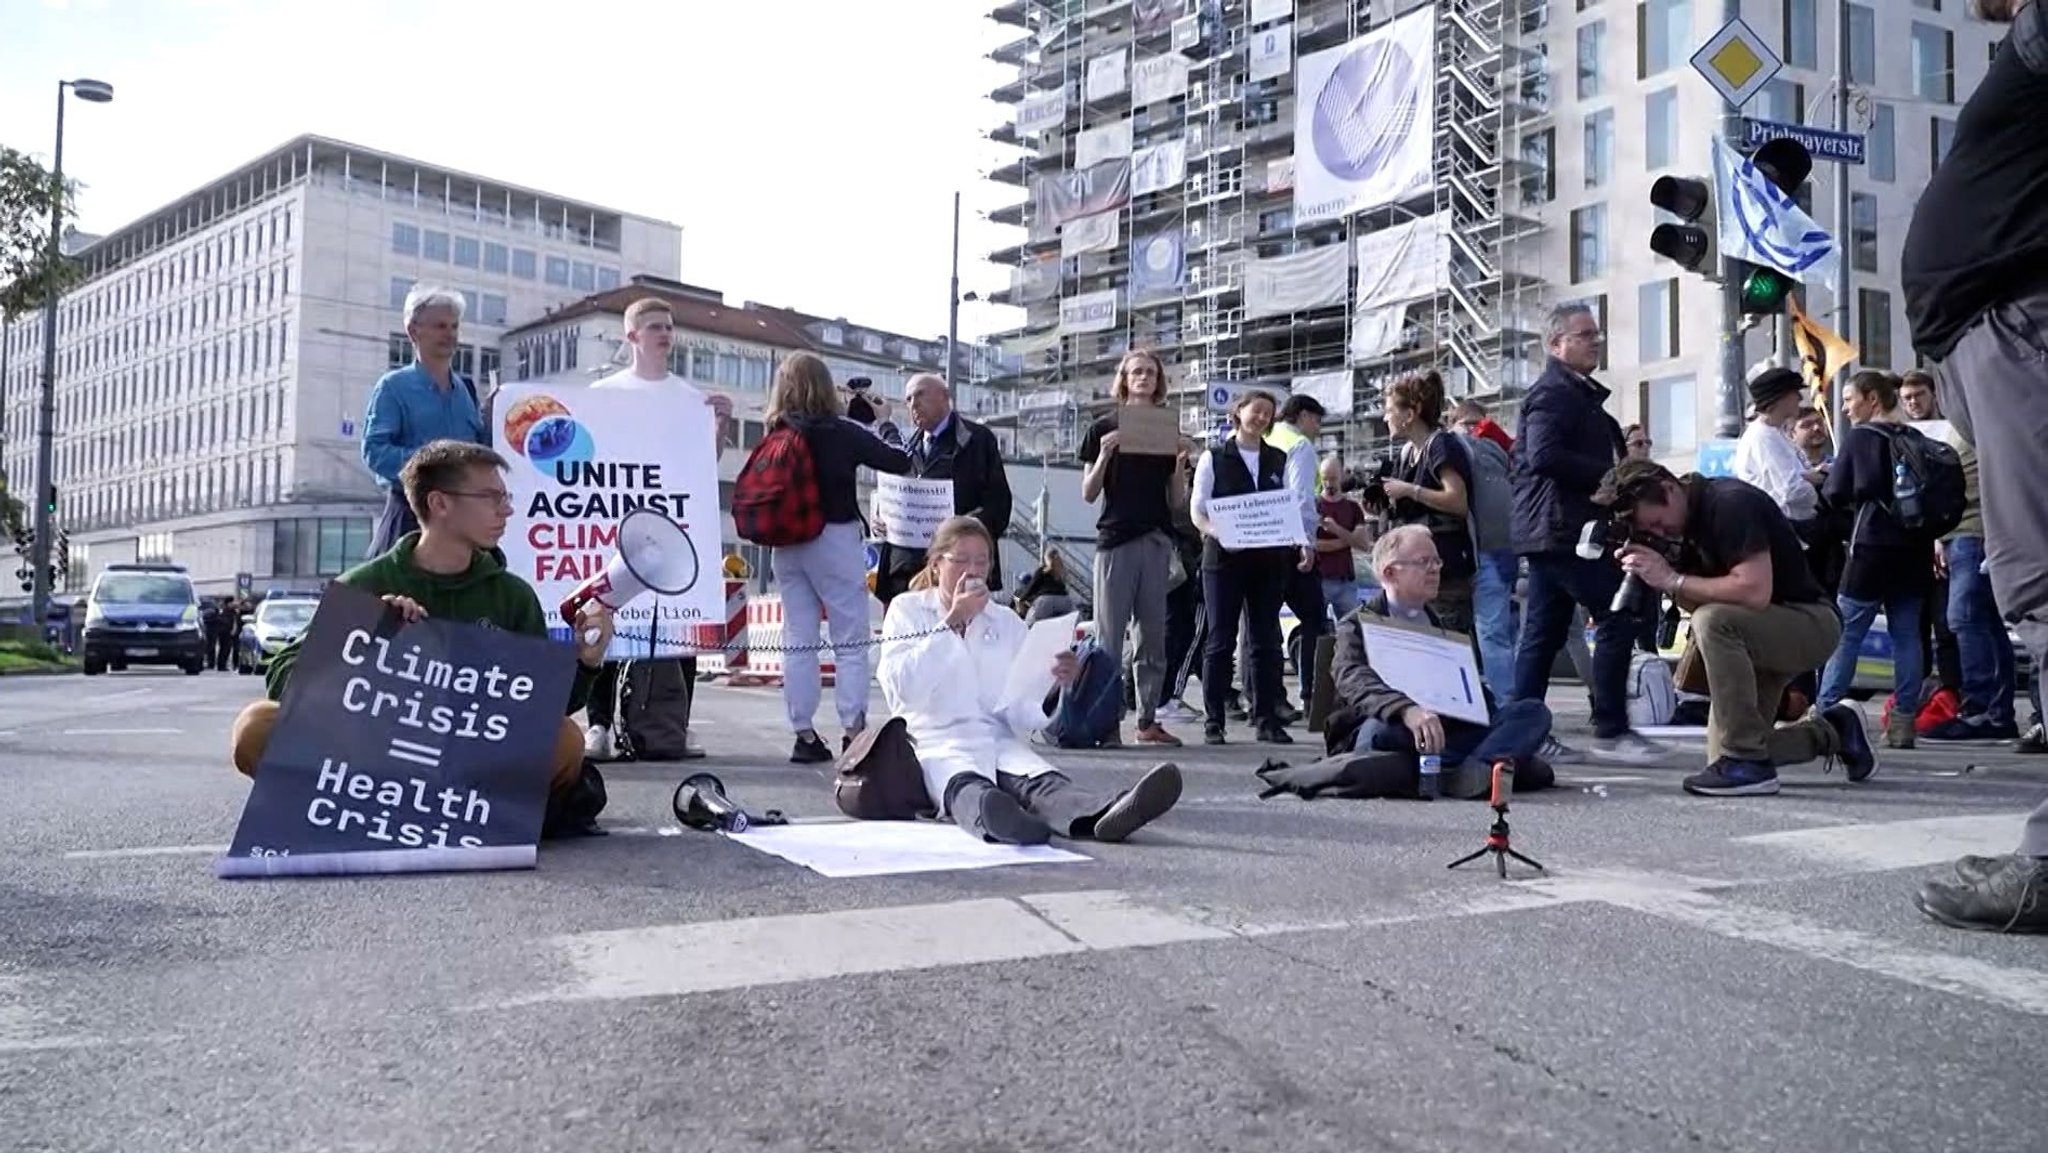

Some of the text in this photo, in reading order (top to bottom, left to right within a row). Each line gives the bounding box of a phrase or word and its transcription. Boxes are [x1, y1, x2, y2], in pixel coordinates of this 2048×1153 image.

[556, 460, 662, 489] UNITE
[527, 491, 691, 518] AGAINST
[342, 629, 534, 700] Climate
[342, 677, 510, 741] Crisis
[316, 758, 490, 825] Health
[307, 798, 483, 849] Crisis
